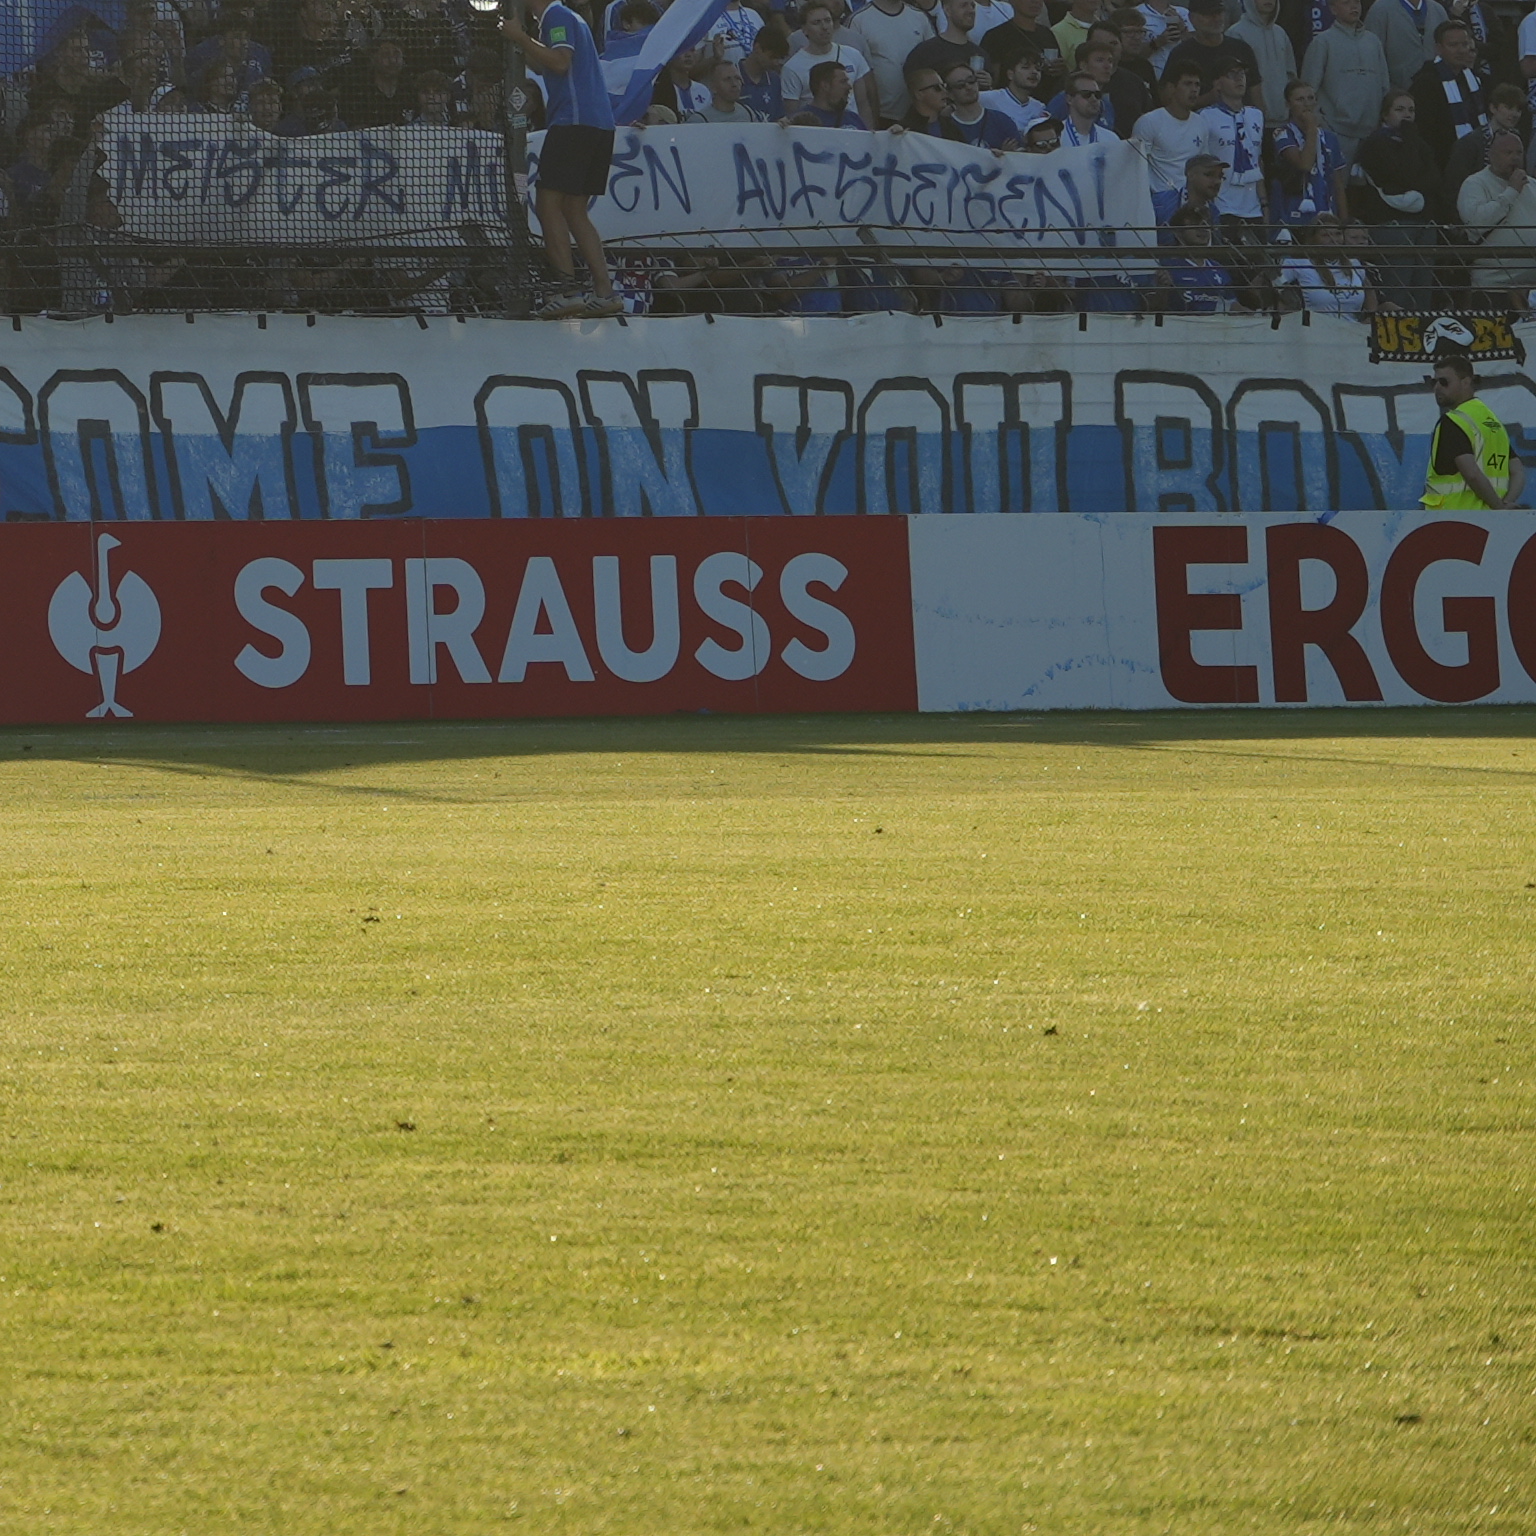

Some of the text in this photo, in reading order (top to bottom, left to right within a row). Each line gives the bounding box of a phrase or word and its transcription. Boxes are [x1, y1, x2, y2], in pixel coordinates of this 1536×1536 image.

[474, 368, 706, 518] ON
[754, 369, 1073, 514] YOU
[1114, 368, 1536, 512] BOY
[1486, 452, 1507, 471] 47
[233, 552, 857, 690] STRAUSS
[1152, 519, 1536, 705] ERG
